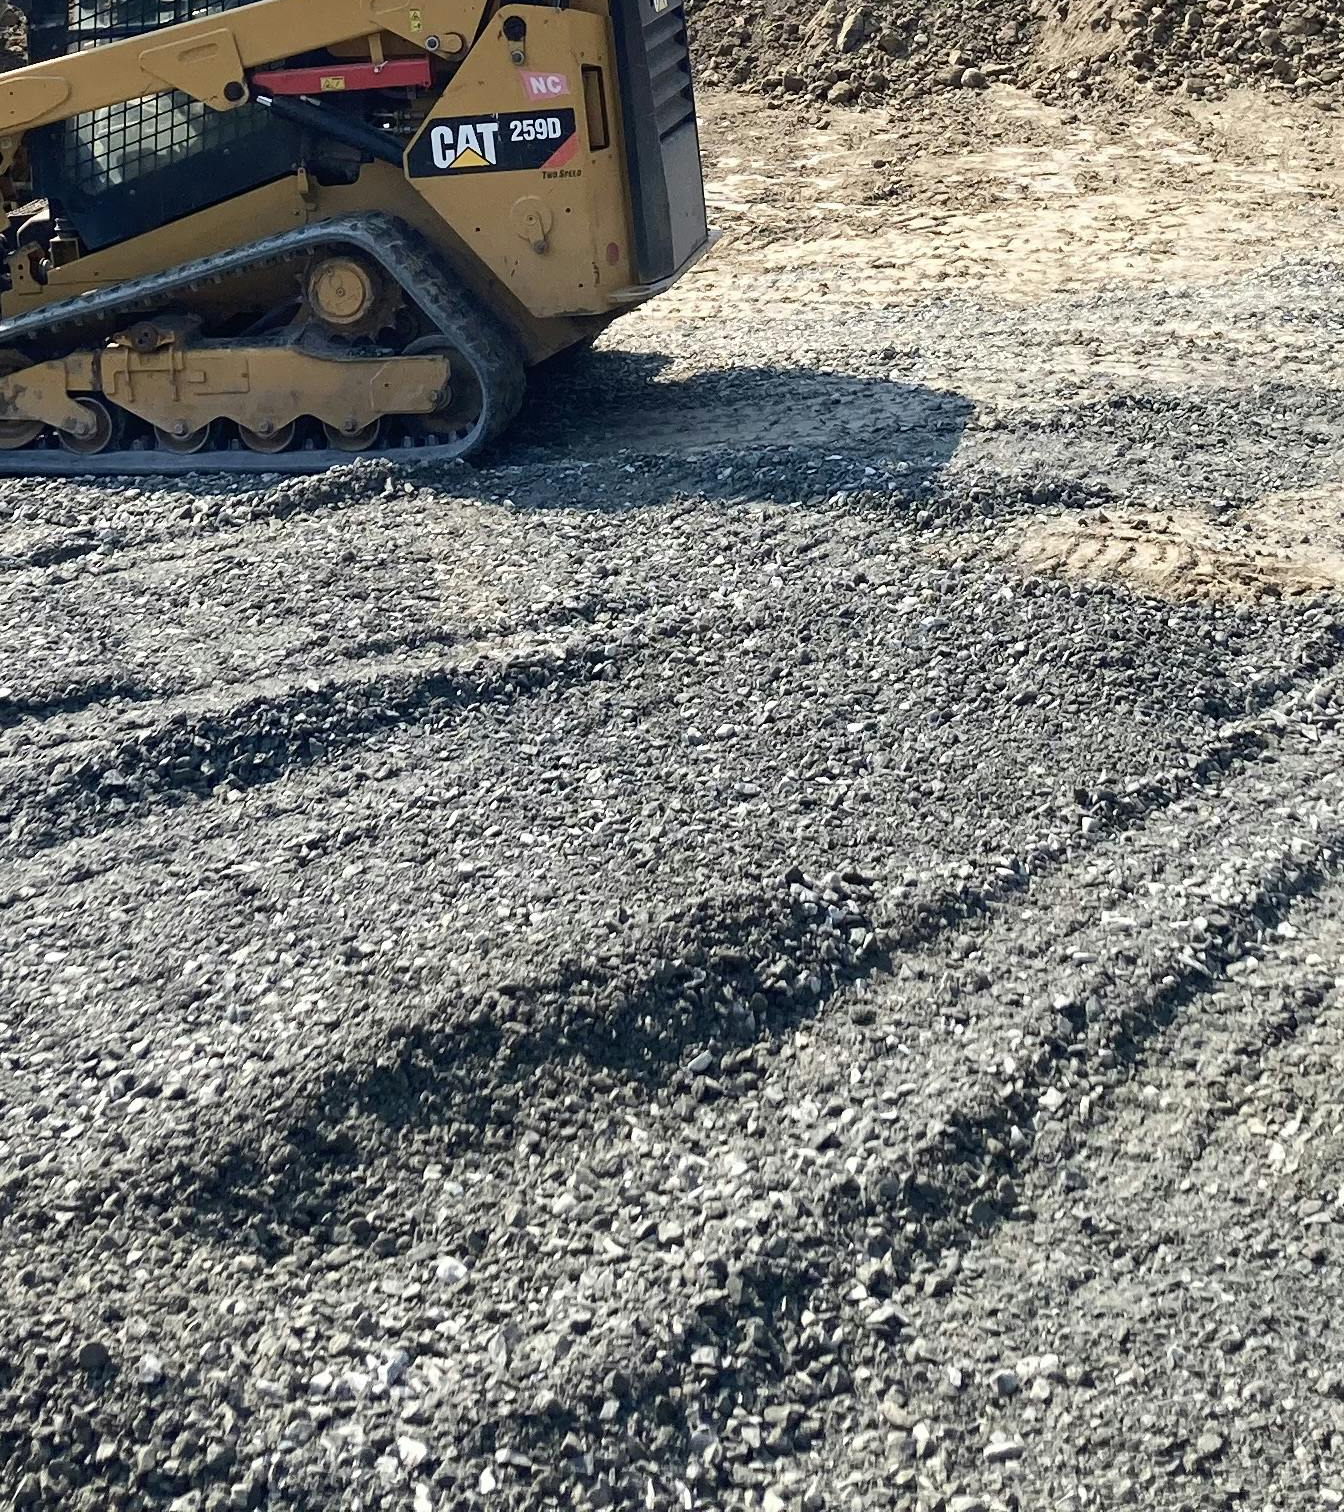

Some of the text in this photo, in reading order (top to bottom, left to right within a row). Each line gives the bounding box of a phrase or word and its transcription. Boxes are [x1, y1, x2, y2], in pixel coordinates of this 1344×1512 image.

[530, 75, 562, 94] NC
[430, 117, 562, 169] CAT 259D
